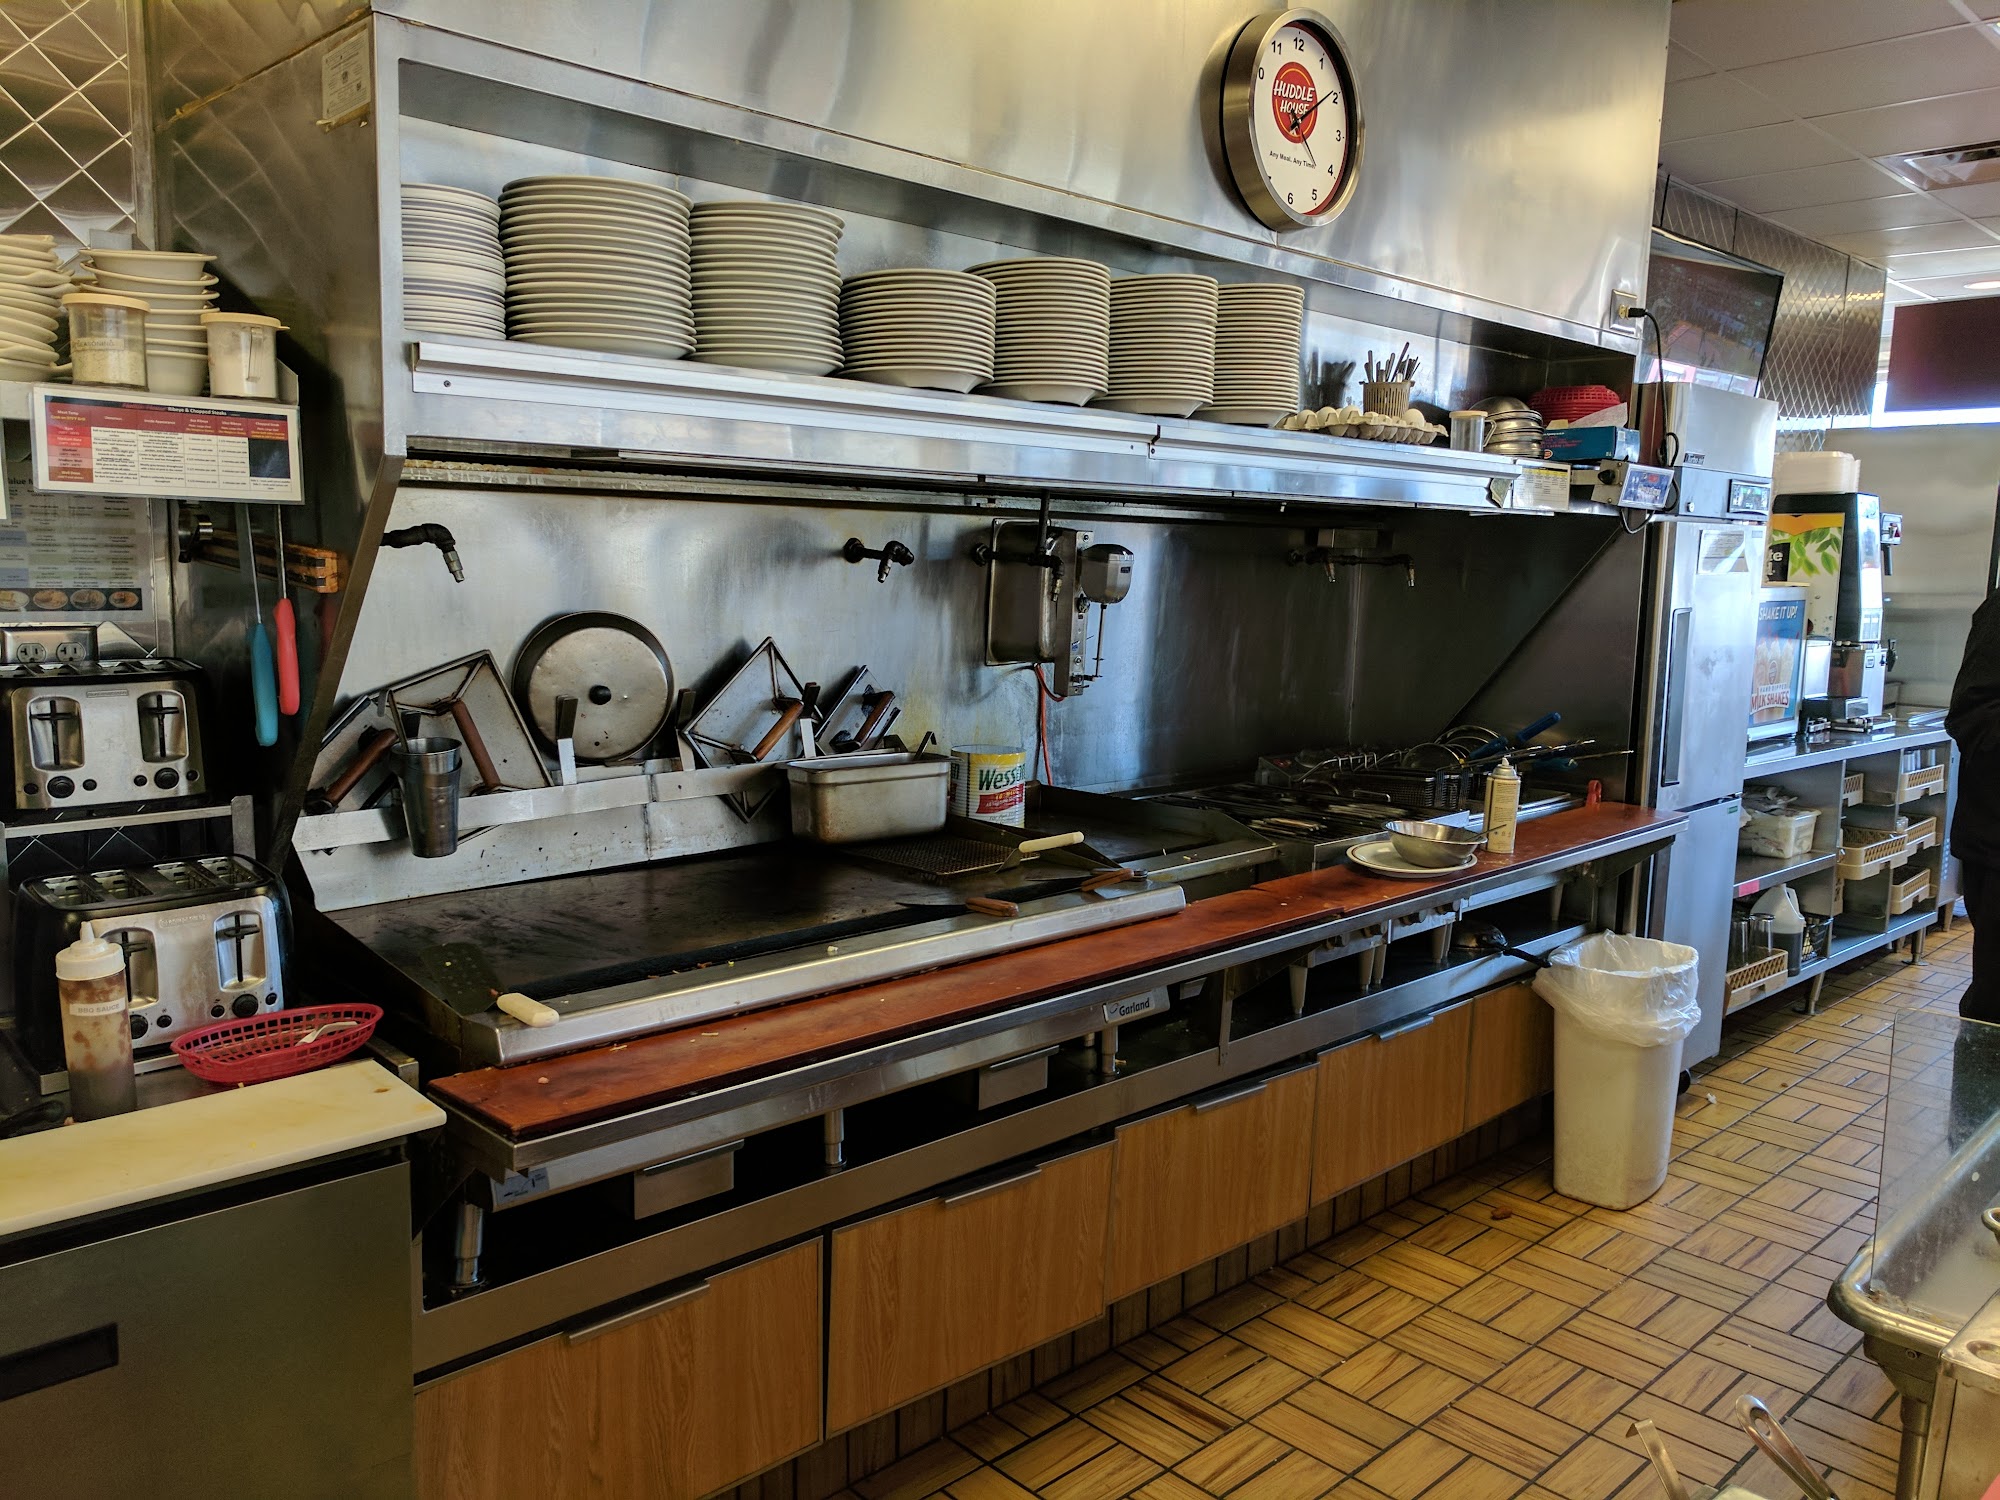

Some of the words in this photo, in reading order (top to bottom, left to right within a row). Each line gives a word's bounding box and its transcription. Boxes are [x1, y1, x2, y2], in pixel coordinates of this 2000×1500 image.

[1271, 40, 1283, 55] 11
[1293, 36, 1304, 52] 12
[1319, 57, 1324, 70] 1
[1258, 67, 1265, 80] 0
[1274, 80, 1315, 102] HUDDLE
[1332, 92, 1338, 105] 2
[1280, 100, 1310, 115] HOUSE
[1335, 129, 1341, 142] 3
[1327, 164, 1334, 177] 4
[1287, 192, 1293, 205] 6
[1311, 189, 1318, 201] 5
[1759, 606, 1780, 621] SHAKE
[1780, 606, 1786, 619] IT
[1786, 605, 1798, 619] UP!
[1767, 691, 1789, 706] SHAKES
[96, 1003, 120, 1013] SAUCE
[1119, 997, 1150, 1016] Garland
